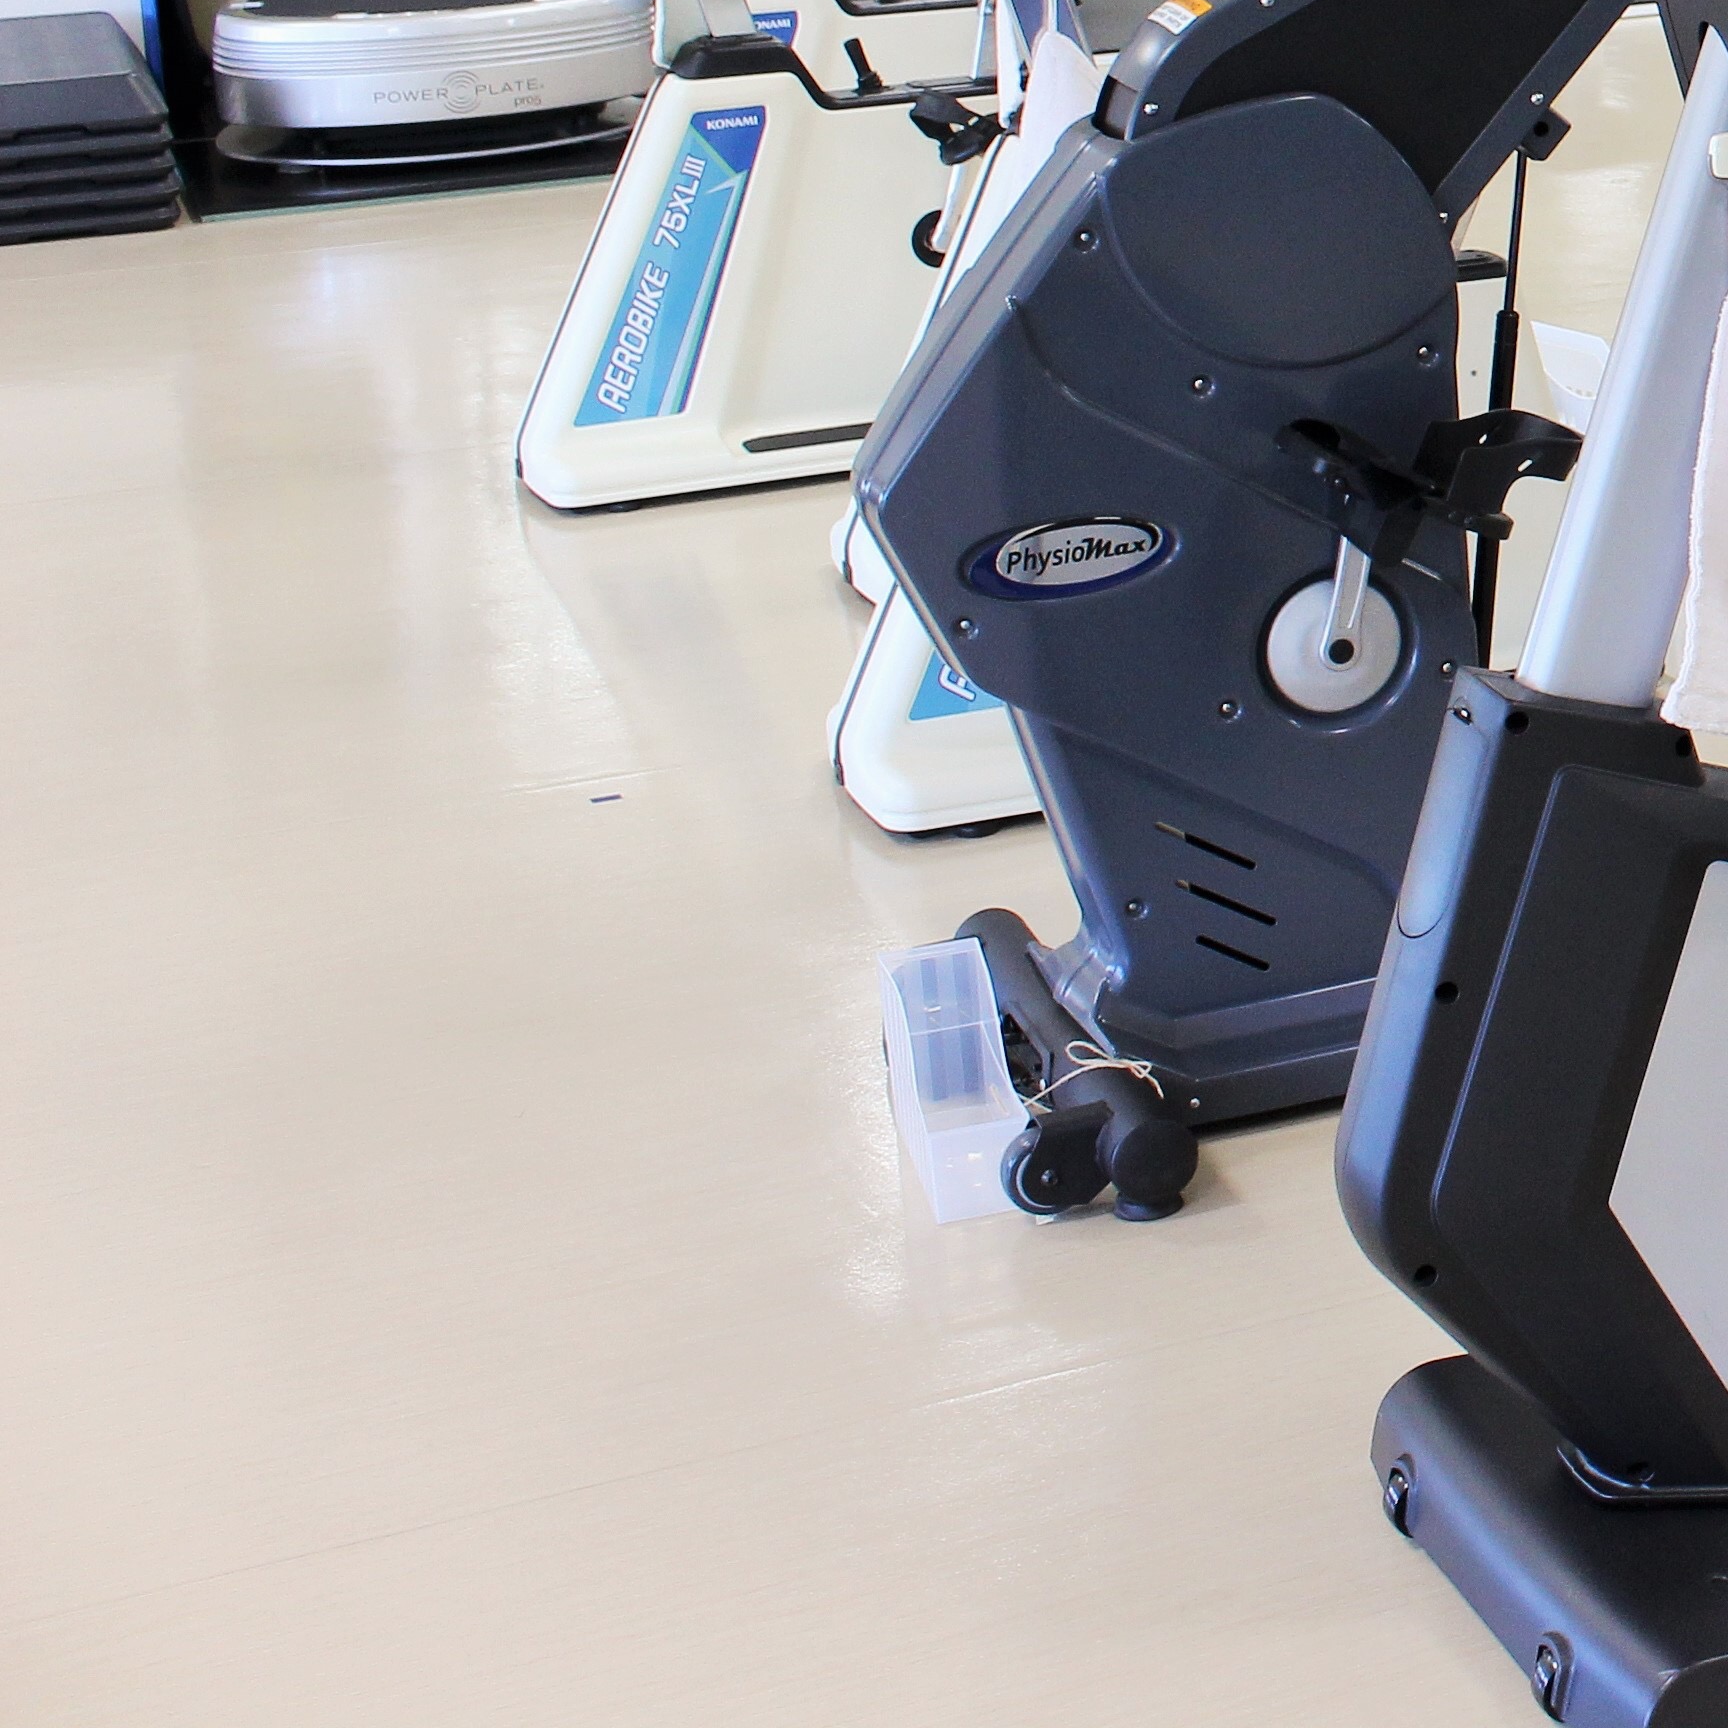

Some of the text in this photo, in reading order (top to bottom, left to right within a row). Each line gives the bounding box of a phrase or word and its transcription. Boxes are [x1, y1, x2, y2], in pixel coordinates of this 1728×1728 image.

[373, 77, 540, 104] POWER PLATE
[706, 115, 759, 131] KONAMI
[597, 260, 671, 414] AEROBIKE
[1006, 537, 1148, 576] PhysioMax
